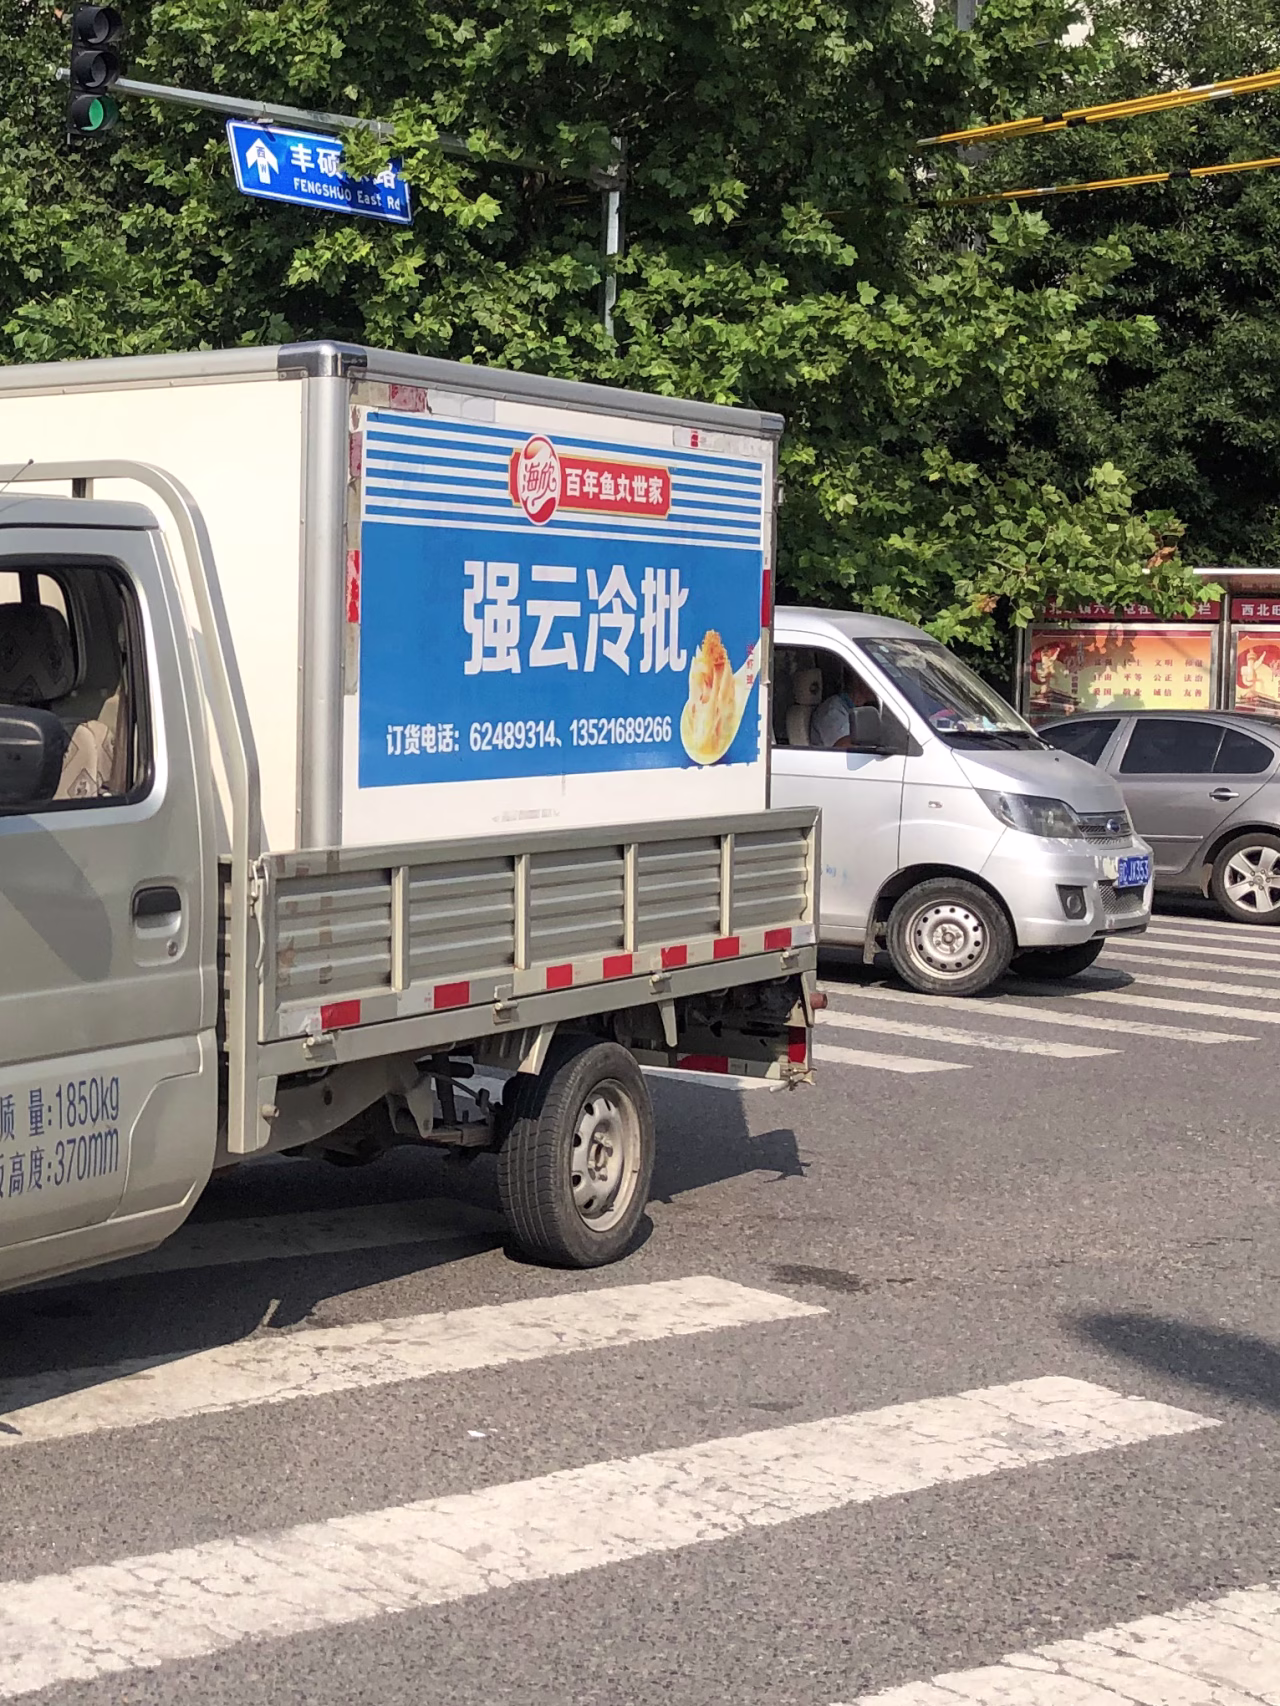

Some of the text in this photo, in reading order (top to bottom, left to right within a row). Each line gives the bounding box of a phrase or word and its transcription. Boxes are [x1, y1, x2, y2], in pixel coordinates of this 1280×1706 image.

[289, 143, 396, 190] 丰硕路
[293, 177, 401, 212] FENGSHUO East Rd
[565, 467, 663, 505] 百年鱼丸世家
[463, 560, 689, 676] 强云冷批
[1124, 673, 1142, 682] 平等
[1154, 673, 1173, 682] 公正
[1184, 674, 1203, 682] 法治
[1154, 659, 1173, 667] 文明
[1093, 687, 1112, 696] 爱国
[1153, 688, 1172, 697] 诚信
[1184, 688, 1203, 697] 友善
